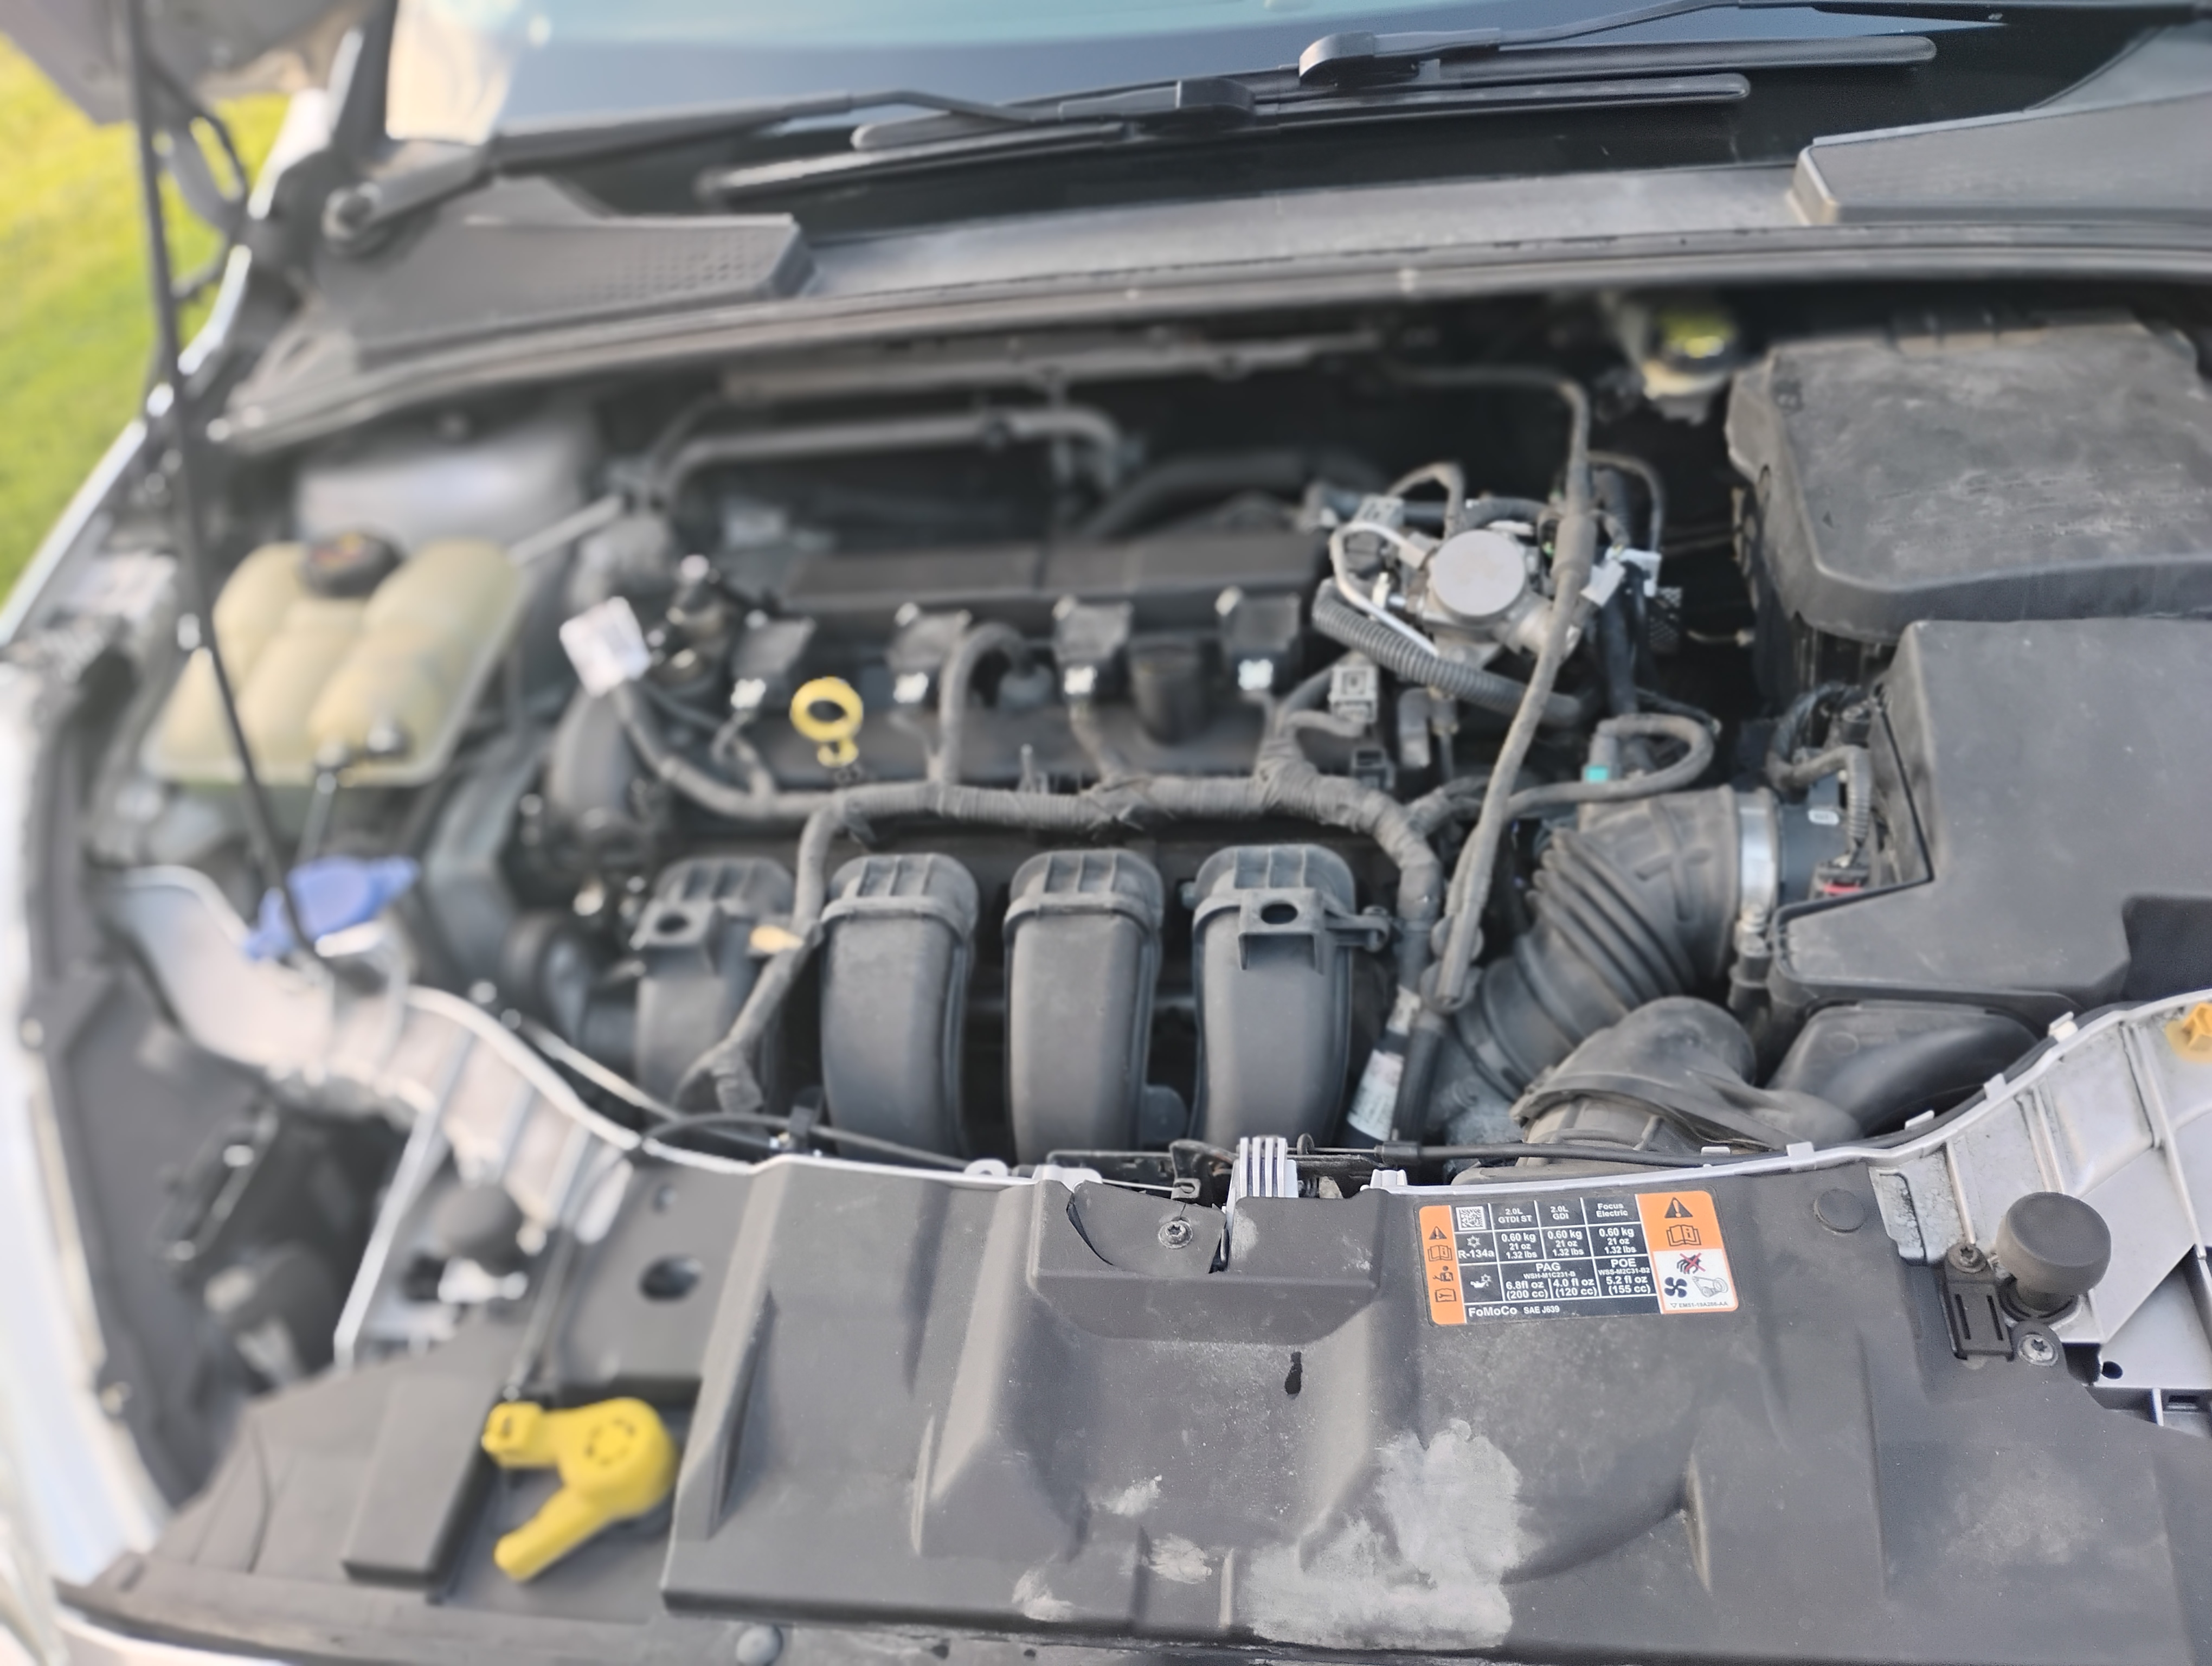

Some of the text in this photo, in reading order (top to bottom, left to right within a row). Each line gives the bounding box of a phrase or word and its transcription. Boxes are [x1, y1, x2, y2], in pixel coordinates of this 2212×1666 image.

[1596, 1209, 1628, 1218] Electric
[1501, 1232, 1536, 1243] 0.60 kg
[1547, 1229, 1583, 1240] 0.60 kg
[1598, 1227, 1635, 1238] 0.60 kg
[1457, 1249, 1495, 1259] R-134a
[1552, 1248, 1570, 1257] 1.32
[1604, 1246, 1622, 1254] 1.32
[1535, 1262, 1561, 1272] PAG
[1610, 1258, 1637, 1268] POE
[1523, 1271, 1576, 1279] WSH-M1C231-B
[1598, 1267, 1650, 1276] WSS-M2C31-B2
[1553, 1278, 1569, 1287] 4.0
[1571, 1278, 1579, 1286] fl
[1606, 1276, 1622, 1285] 5.2
[1624, 1275, 1632, 1284] fl
[1506, 1289, 1548, 1300] (200 cc)
[1555, 1286, 1597, 1298] (120 cc)
[1608, 1284, 1651, 1296] (155 cc)
[1468, 1305, 1560, 1317] FoMoCo SAE J639
